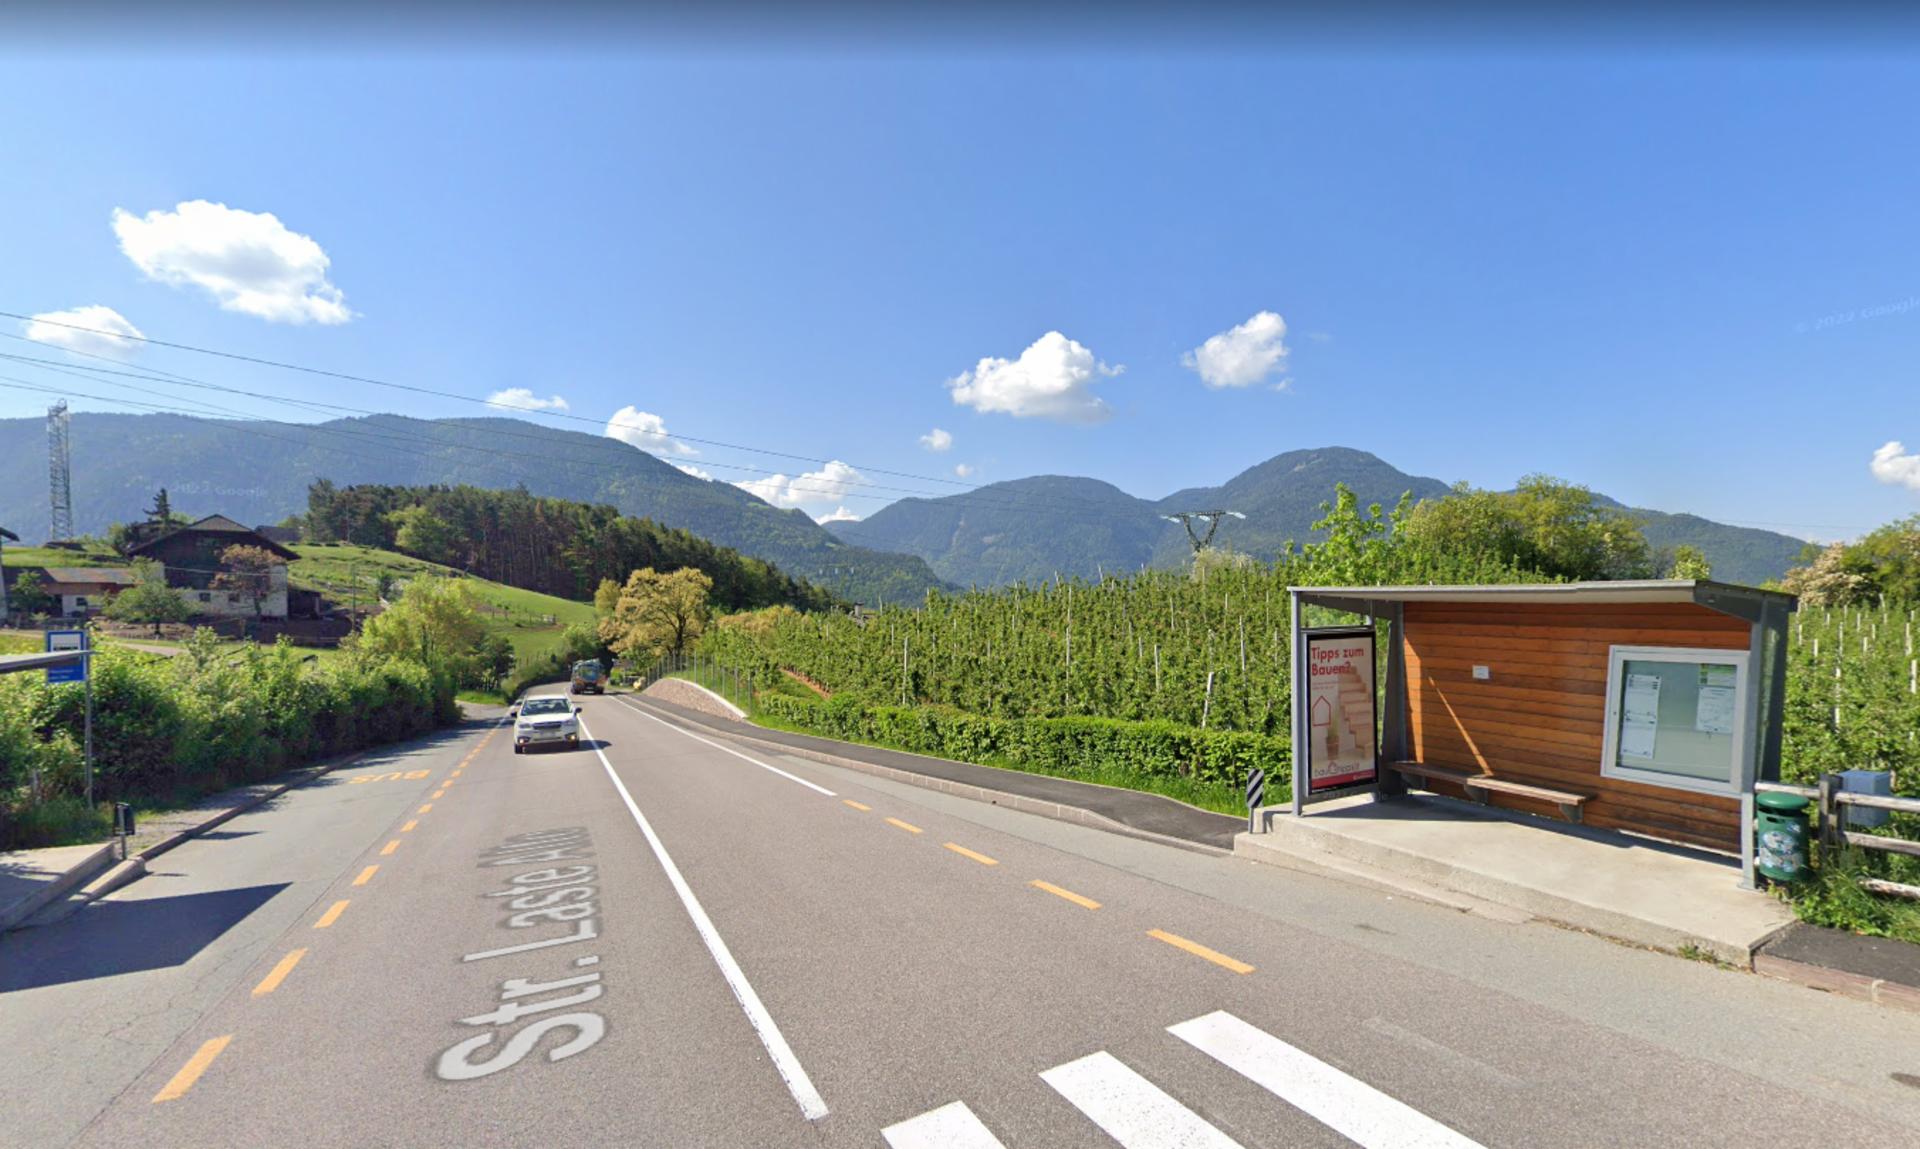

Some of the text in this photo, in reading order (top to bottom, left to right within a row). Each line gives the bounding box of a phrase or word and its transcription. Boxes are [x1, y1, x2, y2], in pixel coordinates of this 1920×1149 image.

[1311, 646, 1365, 662] Tipps zum
[1311, 661, 1351, 676] Bauen?
[347, 768, 432, 784] BUS
